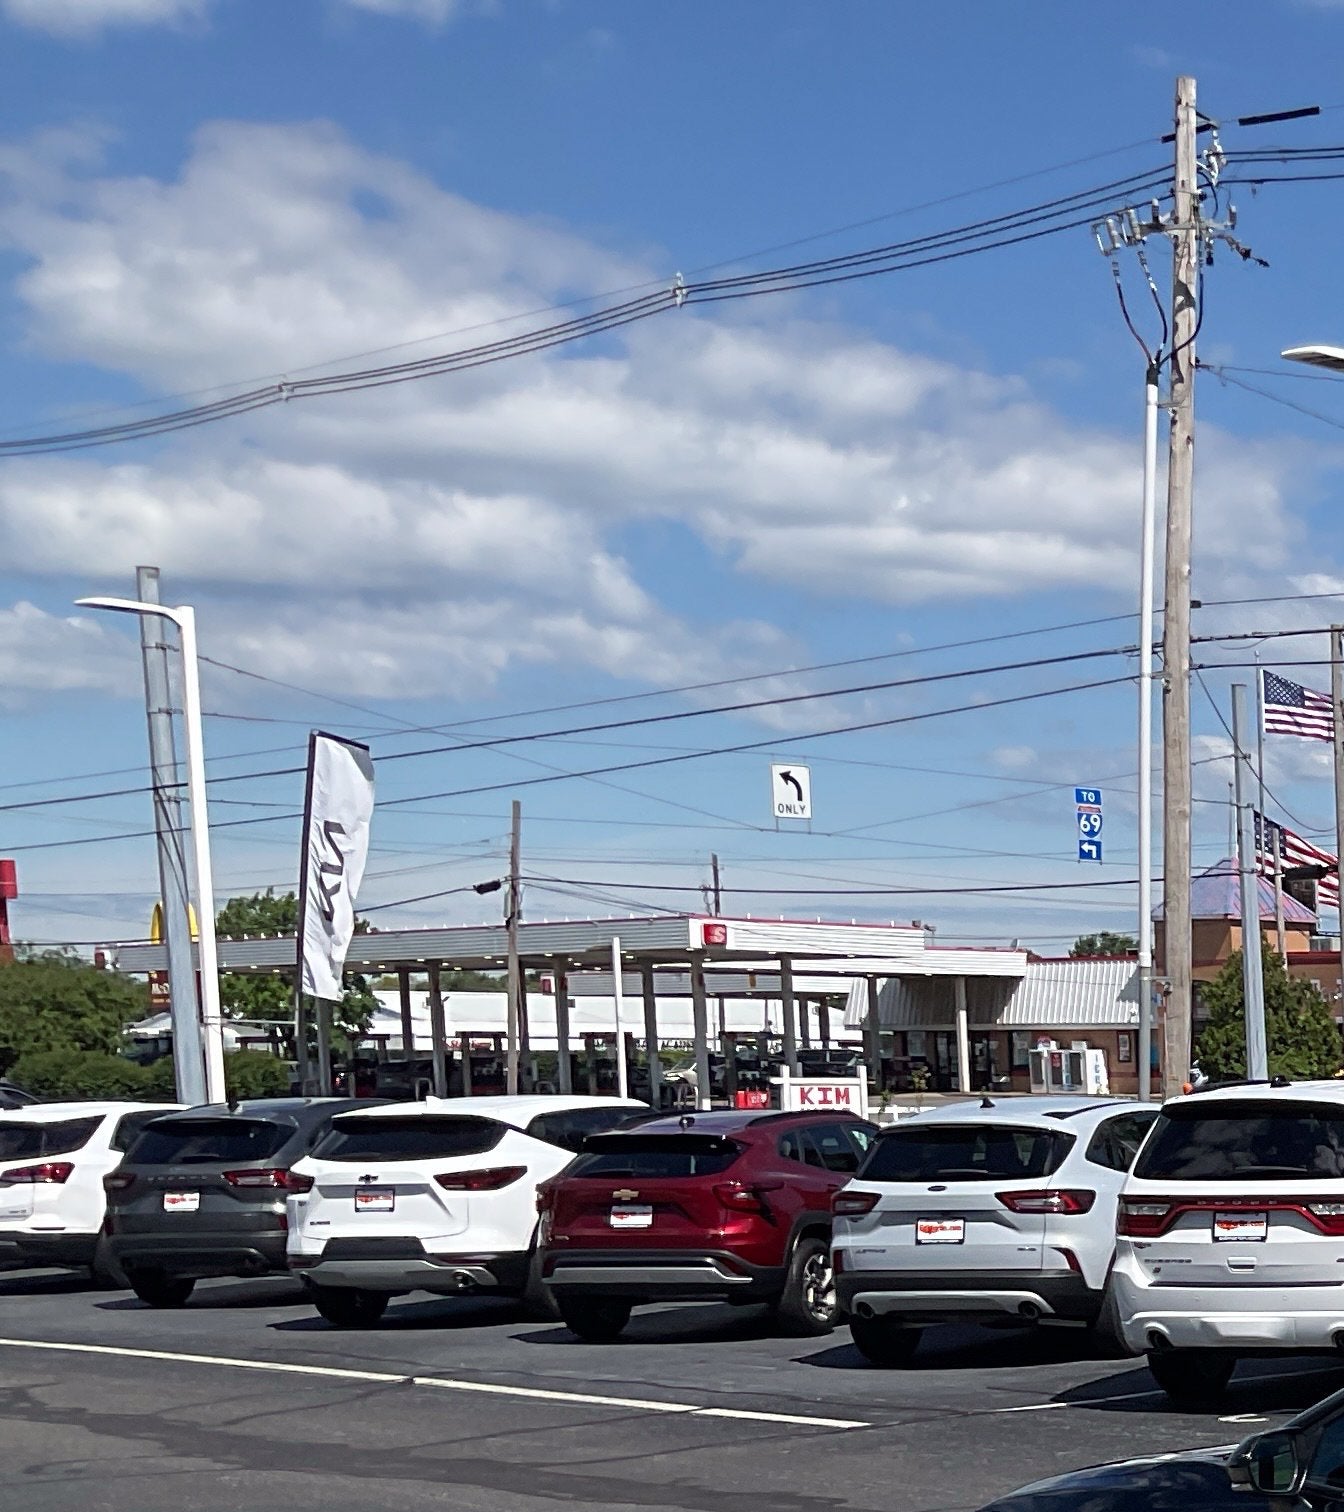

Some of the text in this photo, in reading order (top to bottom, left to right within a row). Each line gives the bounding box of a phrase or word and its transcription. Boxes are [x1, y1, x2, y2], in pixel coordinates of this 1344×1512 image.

[1081, 791, 1095, 803] TO
[778, 803, 806, 815] ONLY
[1080, 814, 1101, 833] 69
[799, 1086, 851, 1105] KIM
